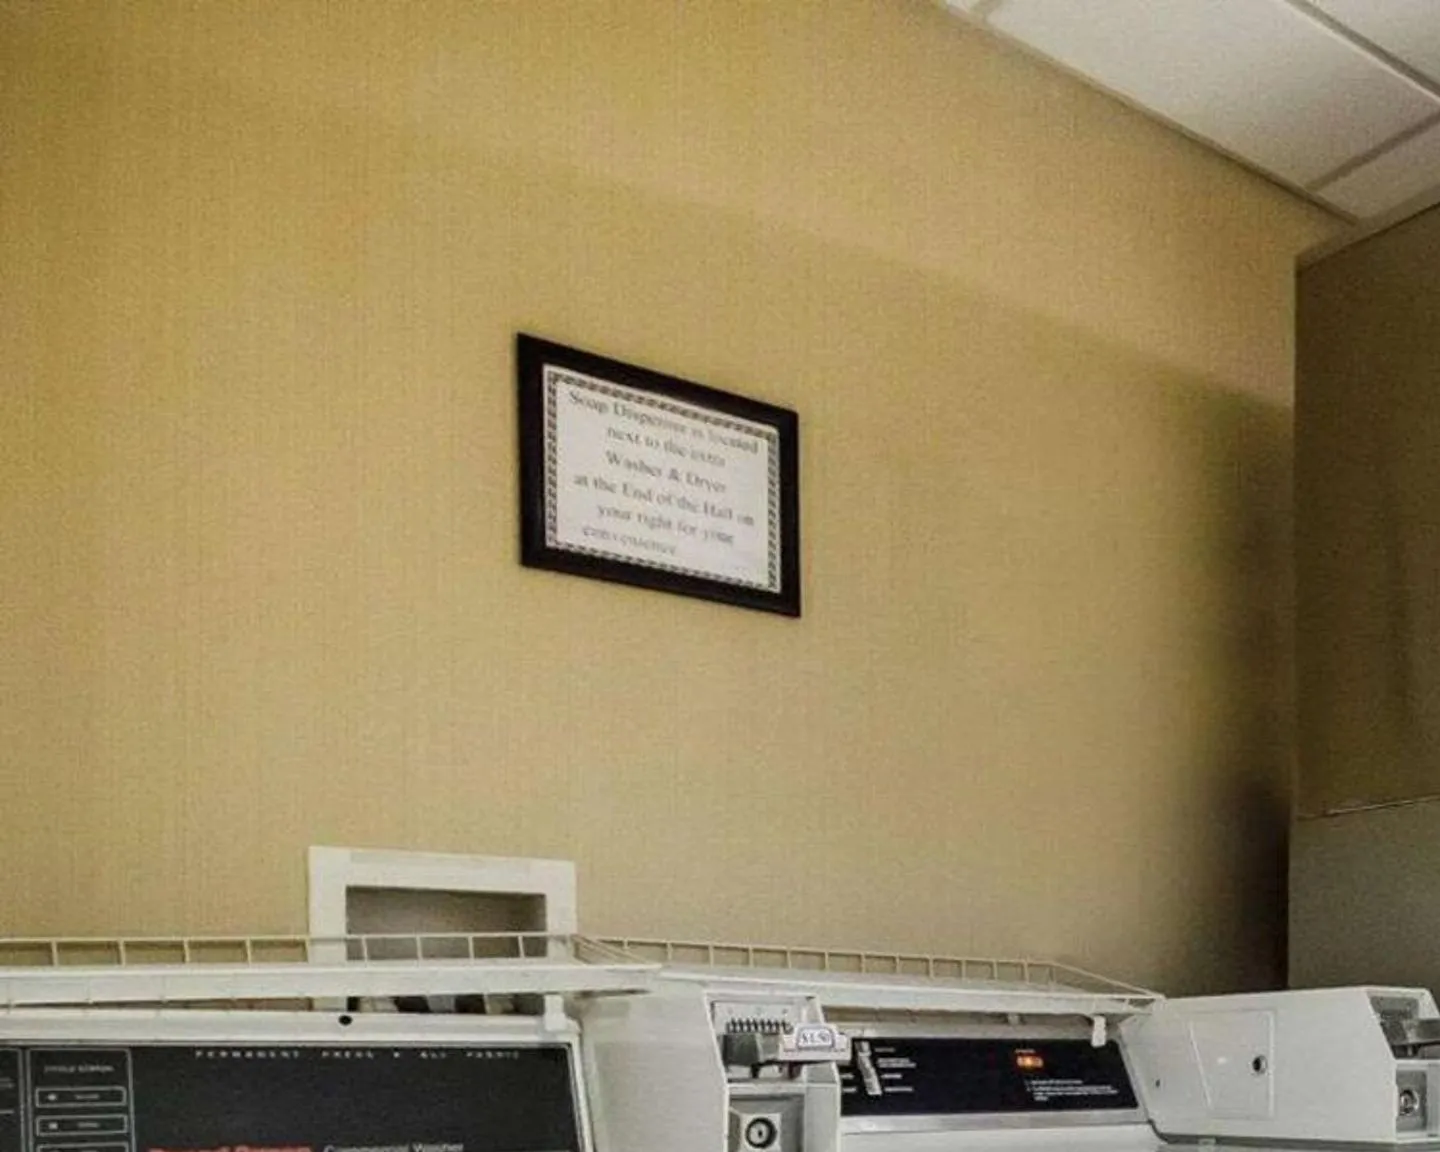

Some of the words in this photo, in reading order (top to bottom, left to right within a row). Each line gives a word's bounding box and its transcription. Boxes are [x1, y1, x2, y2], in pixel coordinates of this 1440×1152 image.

[569, 390, 610, 415] Soap
[607, 427, 640, 445] next
[645, 436, 661, 448] to
[663, 439, 687, 458] the
[605, 450, 662, 477] Washer
[668, 467, 680, 481] &
[686, 471, 727, 494] Dryer
[573, 475, 588, 487] at
[593, 476, 617, 494] the
[622, 482, 652, 503] End
[656, 493, 672, 506] of
[678, 495, 698, 514] the
[703, 500, 733, 520] Hall
[637, 512, 672, 532] right
[677, 519, 698, 537] for
